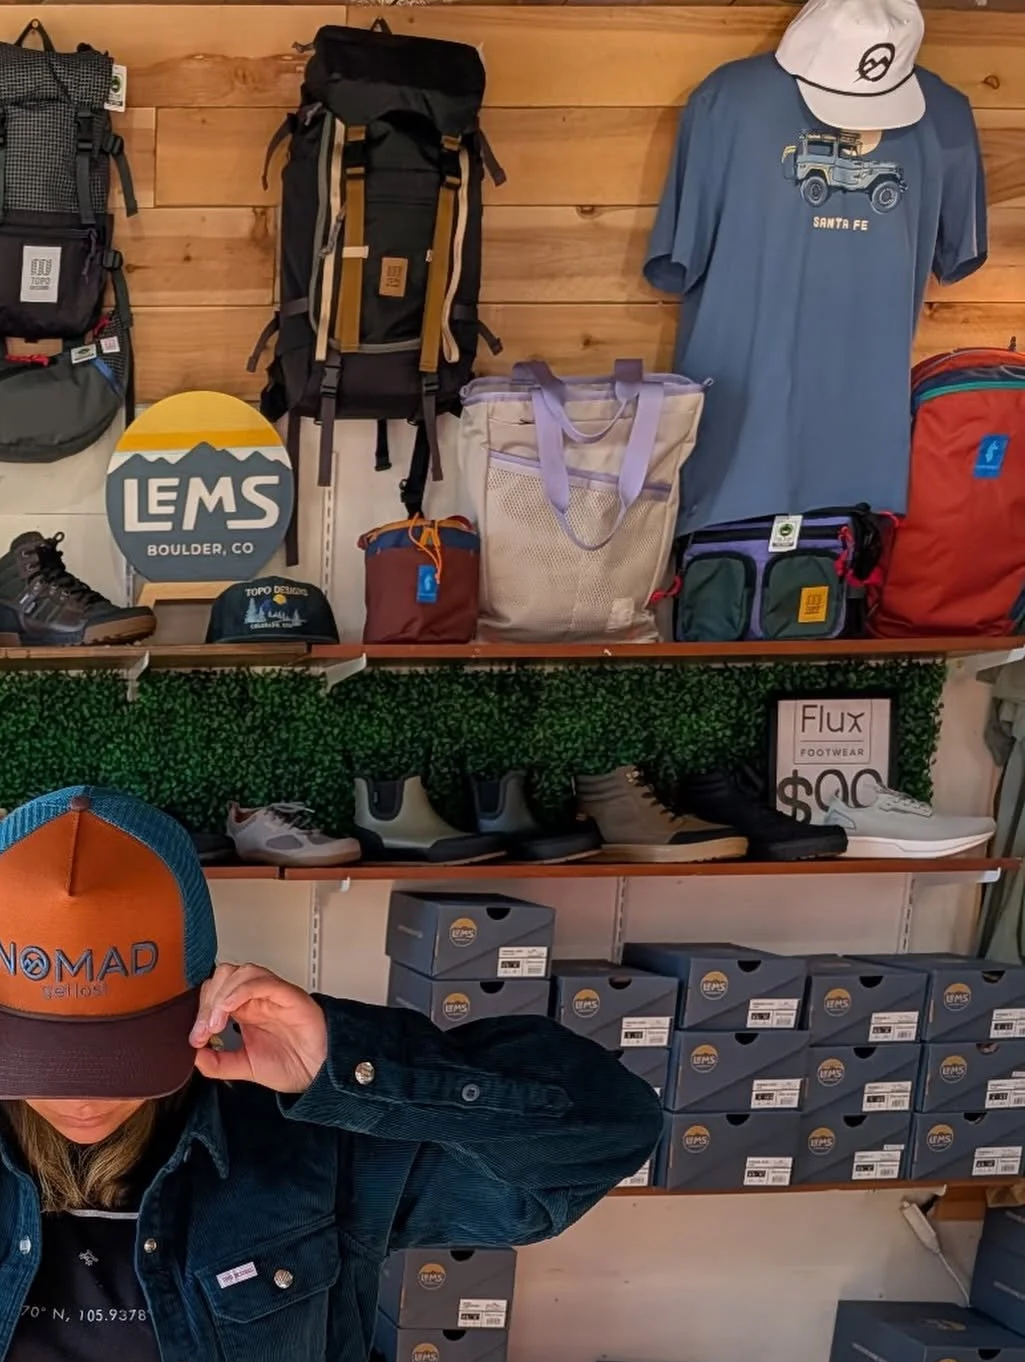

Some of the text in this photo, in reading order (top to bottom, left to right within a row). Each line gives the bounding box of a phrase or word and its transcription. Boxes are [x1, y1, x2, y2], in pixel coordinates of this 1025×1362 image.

[813, 216, 869, 230] SANTA FE
[124, 475, 280, 532] LEMS
[147, 541, 254, 557] BOULDER, CO
[245, 586, 272, 597] TOPO
[801, 704, 865, 733] Flux
[800, 748, 864, 757] FOOTWEAR
[52, 1308, 70, 1322] N,
[79, 1308, 152, 1322] 105.9378
